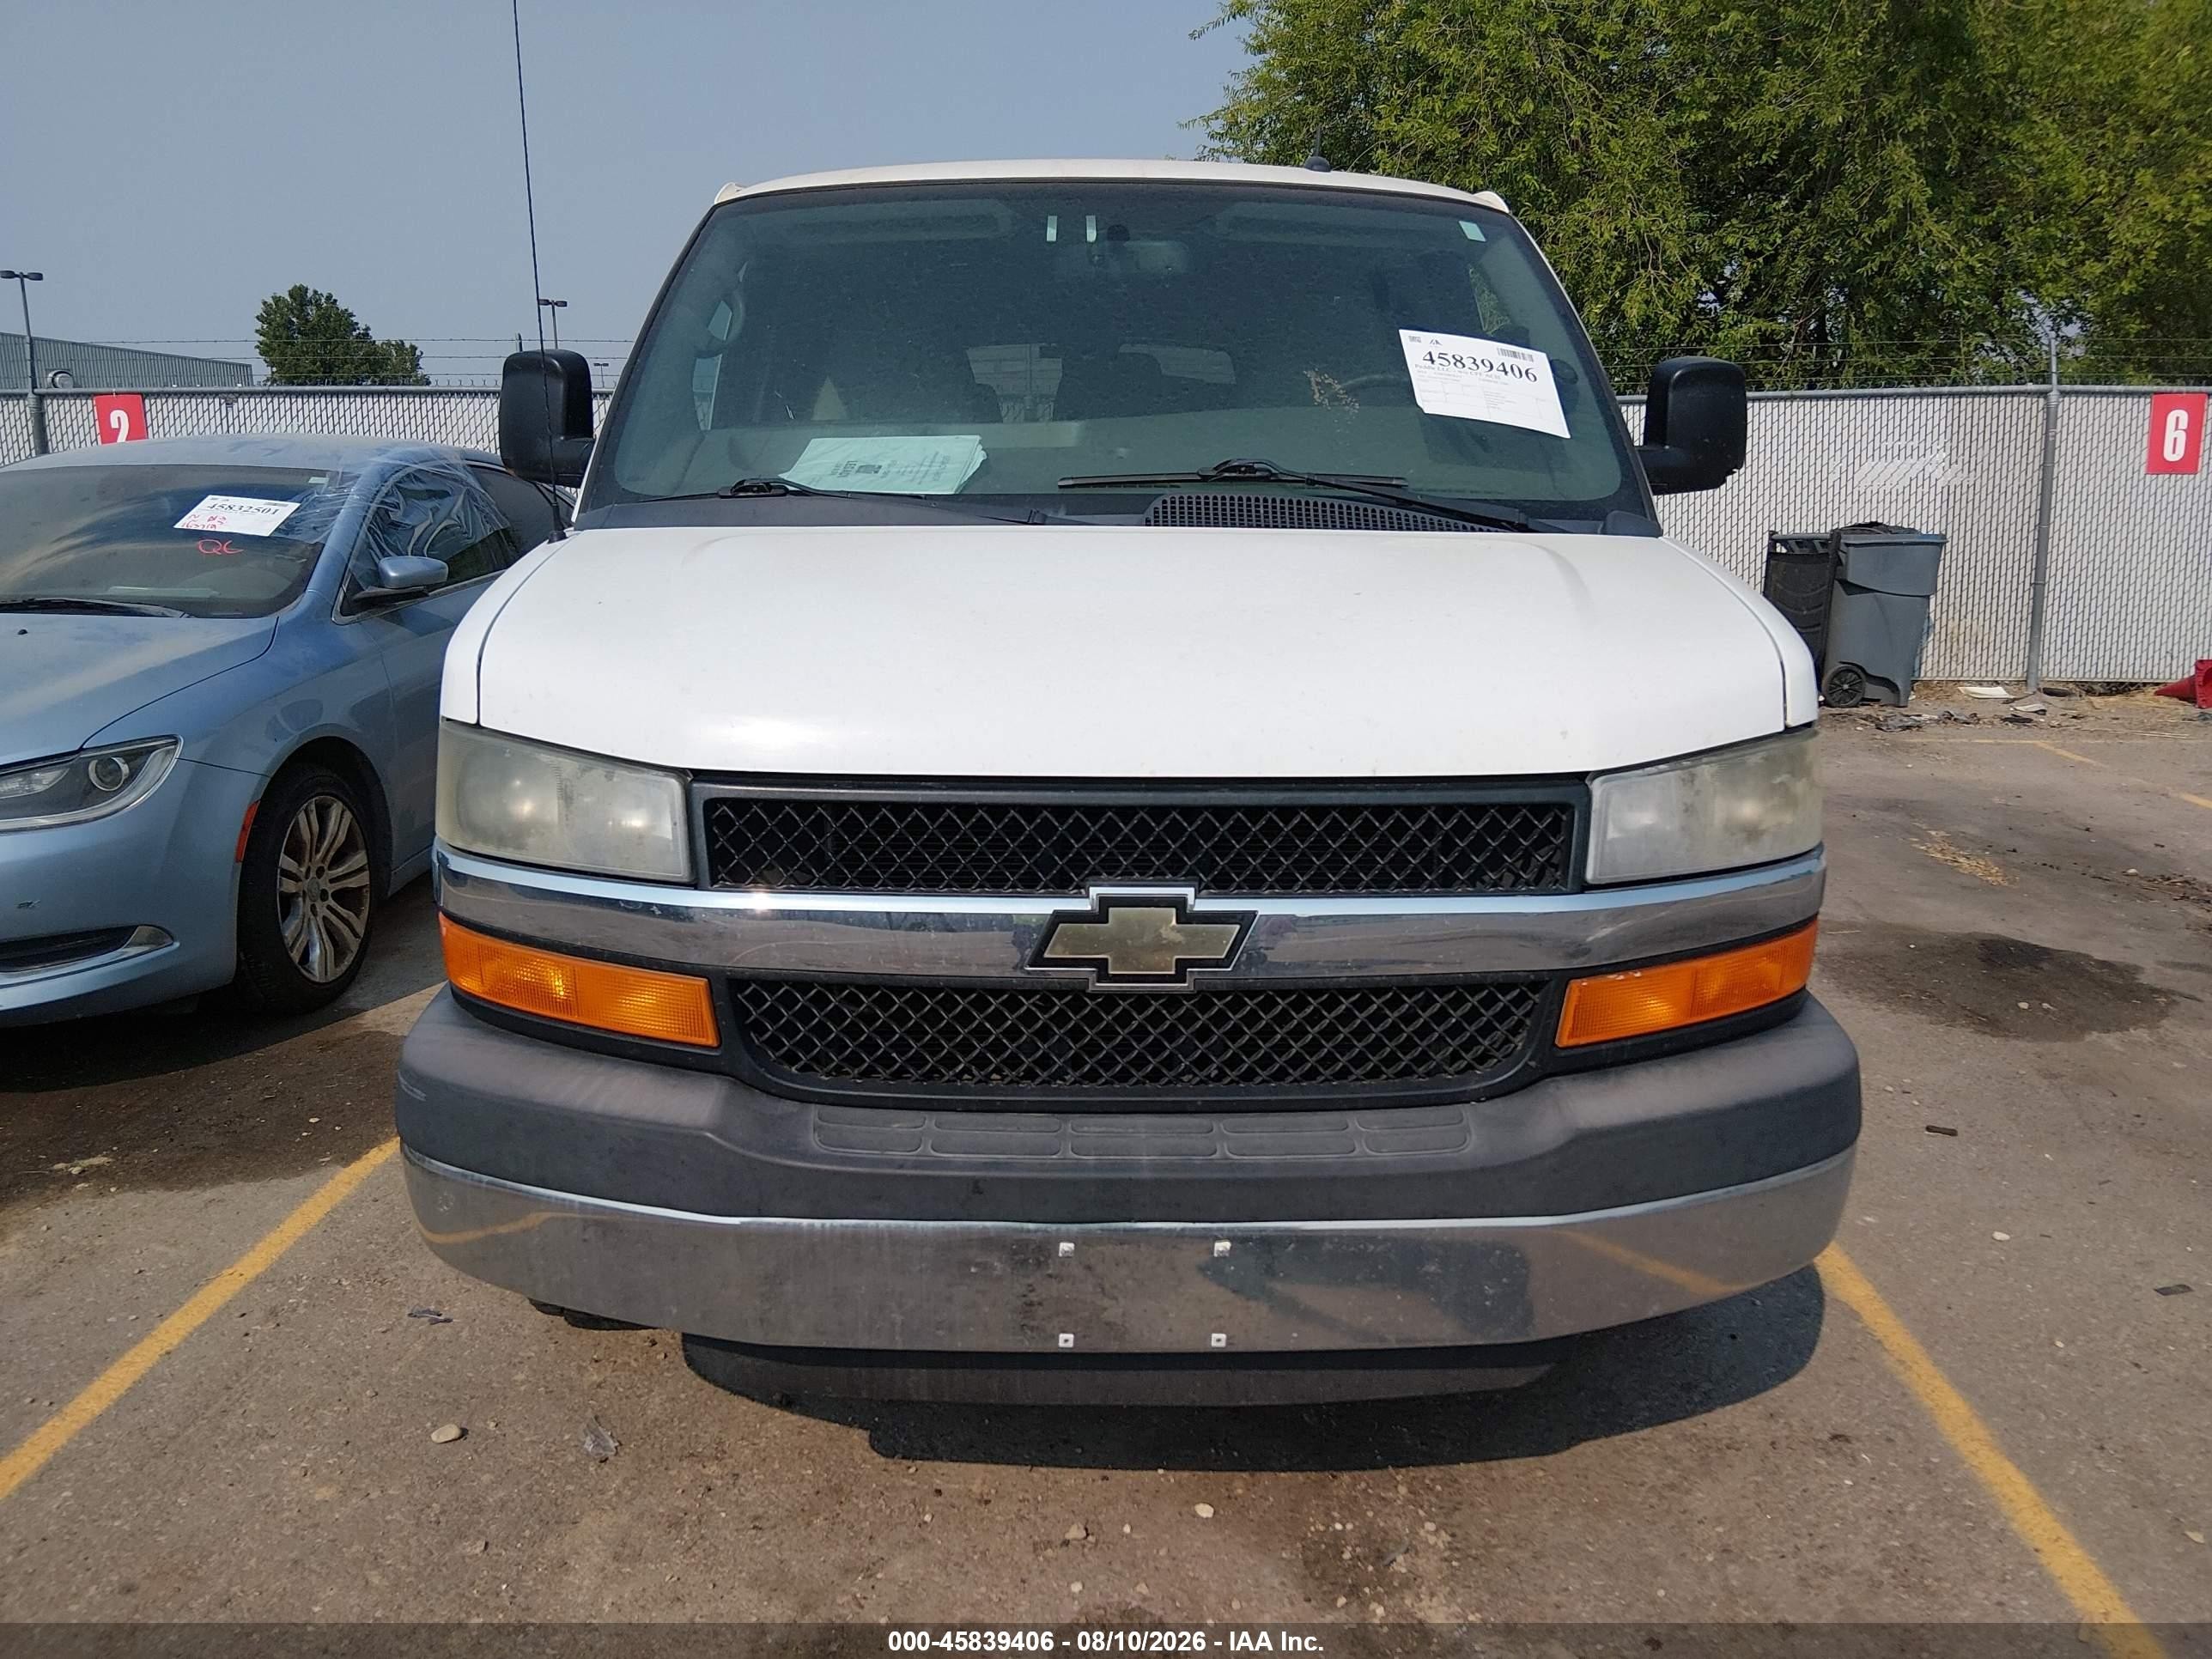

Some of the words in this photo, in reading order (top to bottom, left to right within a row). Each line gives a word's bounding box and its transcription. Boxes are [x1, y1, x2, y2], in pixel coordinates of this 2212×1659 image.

[1422, 350, 1538, 383] 45839406
[110, 410, 130, 443] 2
[2163, 409, 2189, 462] 6
[206, 502, 281, 516] 45832501
